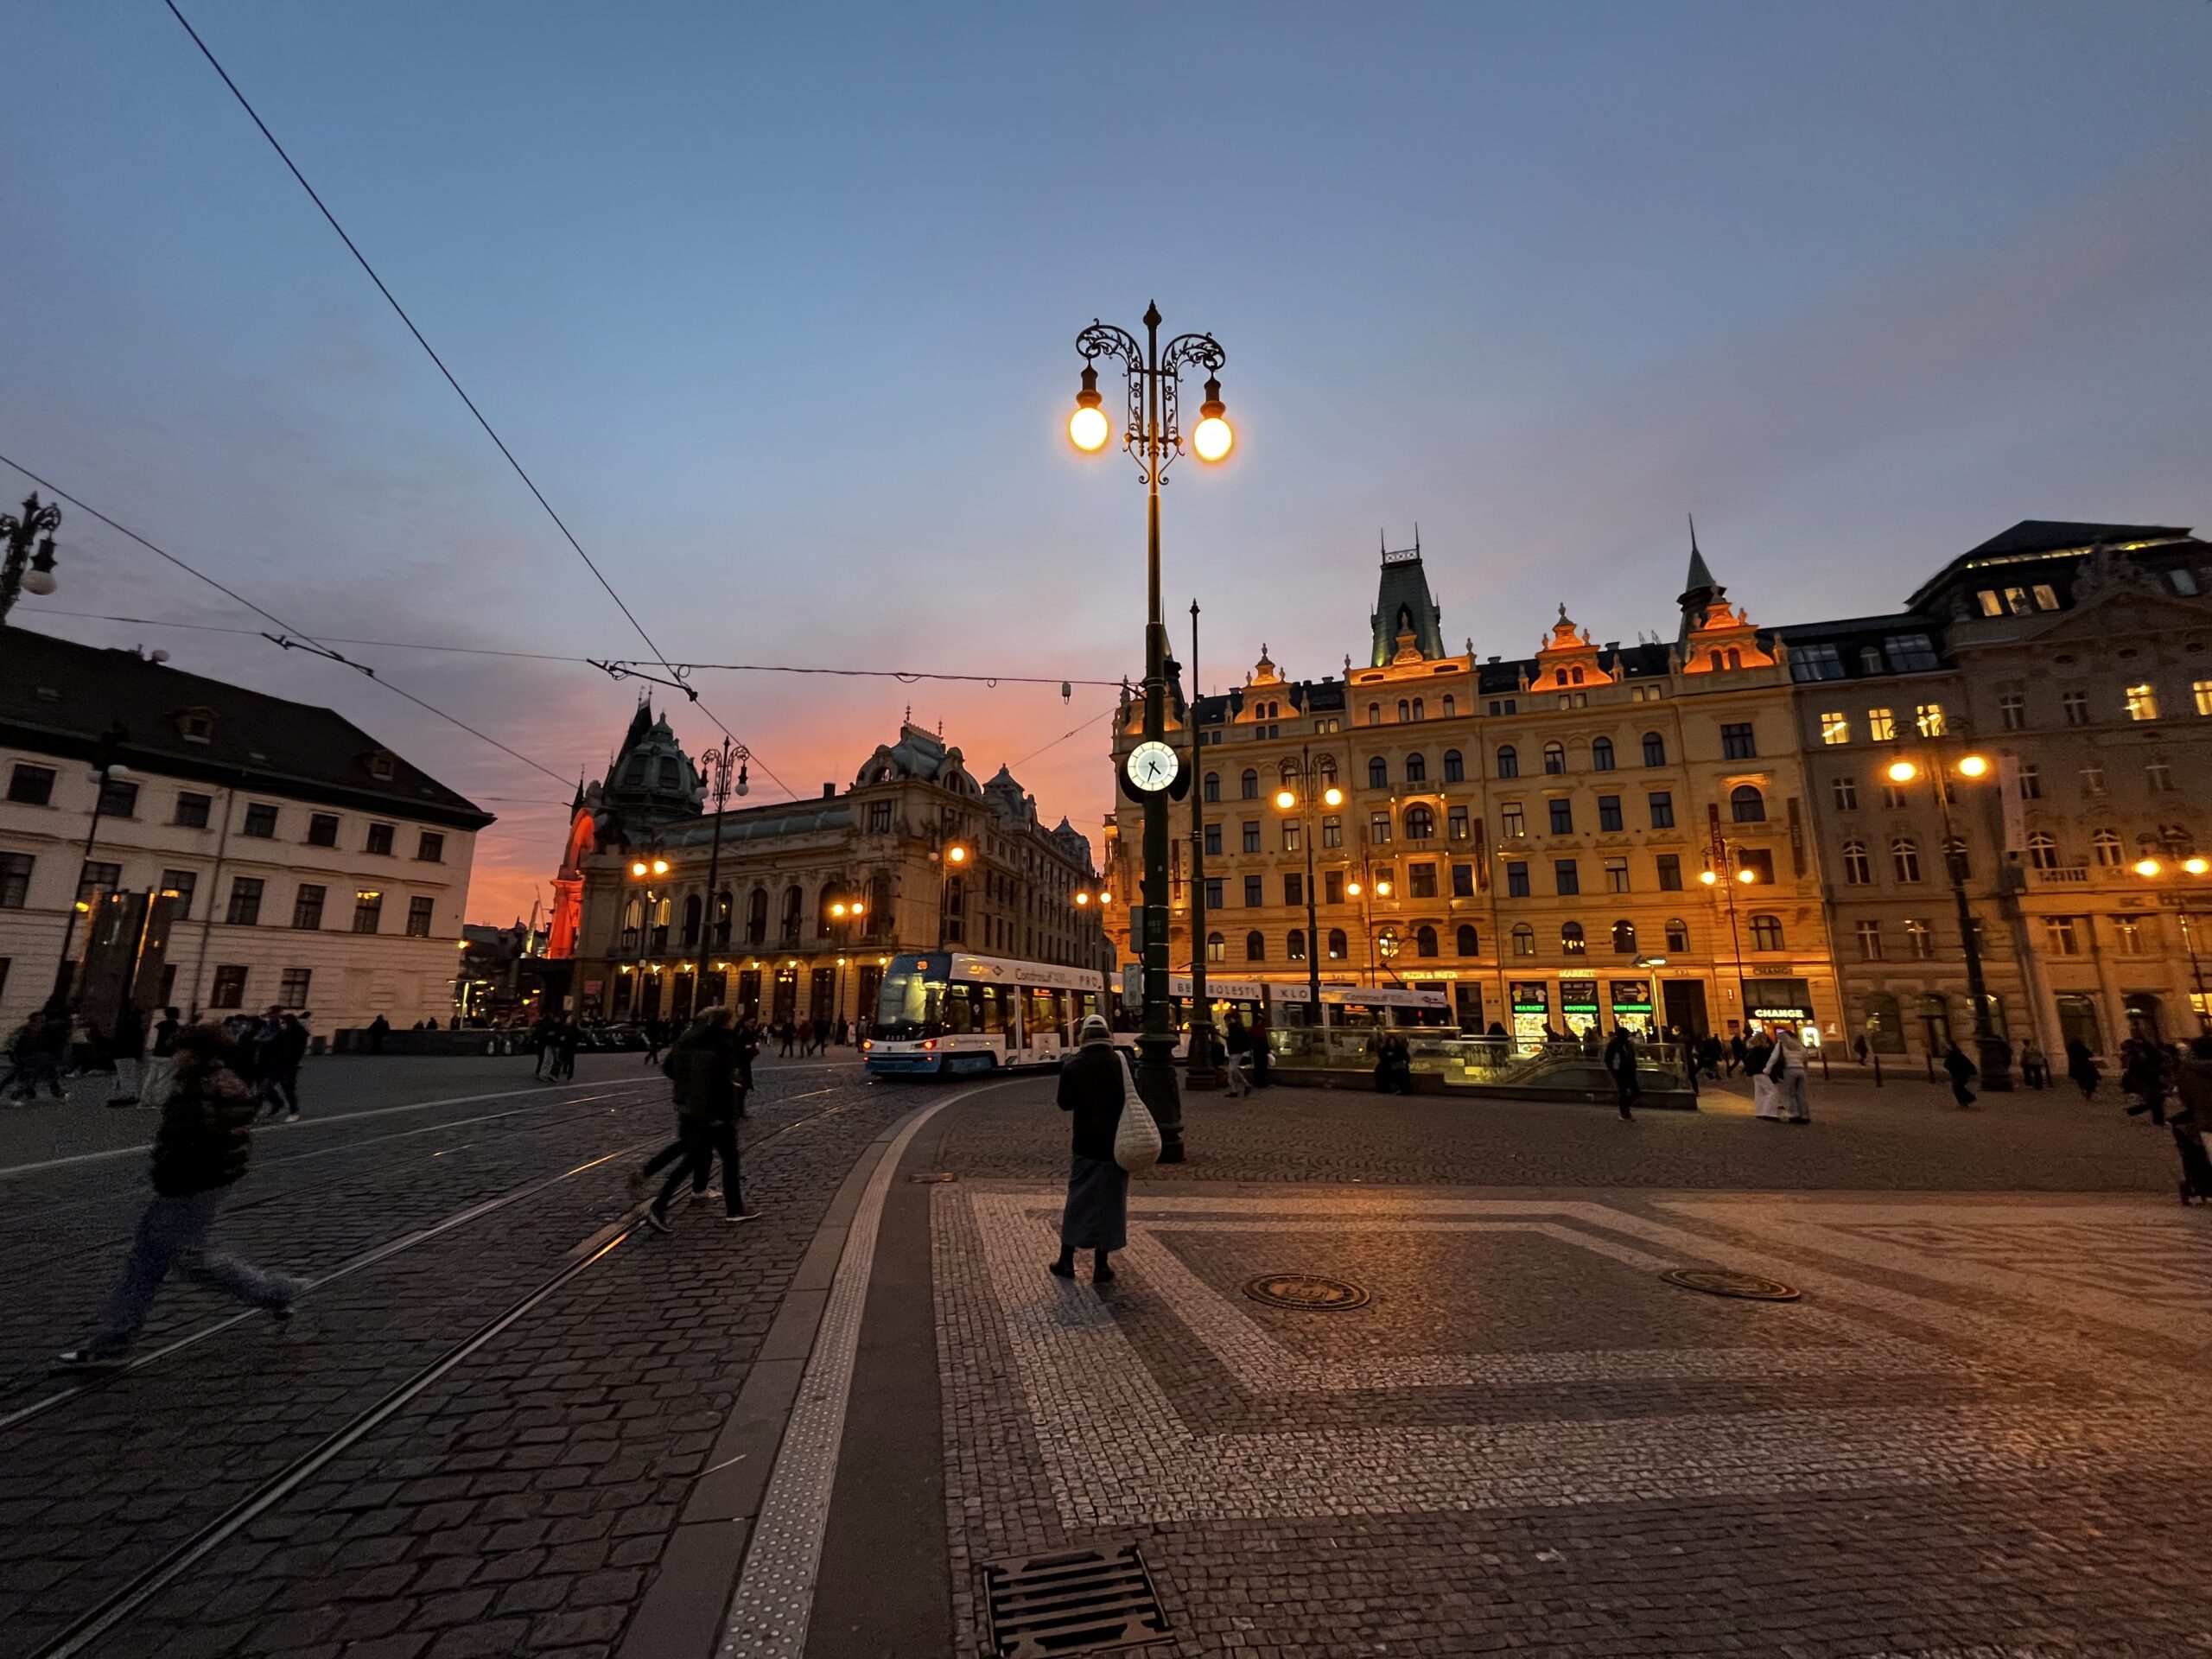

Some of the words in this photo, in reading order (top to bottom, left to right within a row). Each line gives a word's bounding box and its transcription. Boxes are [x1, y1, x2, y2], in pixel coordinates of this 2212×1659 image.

[1559, 969, 1596, 978] MARKET
[1177, 982, 1192, 993] BE
[1281, 988, 1308, 999] KLO
[1754, 1008, 1804, 1018] CHANGE
